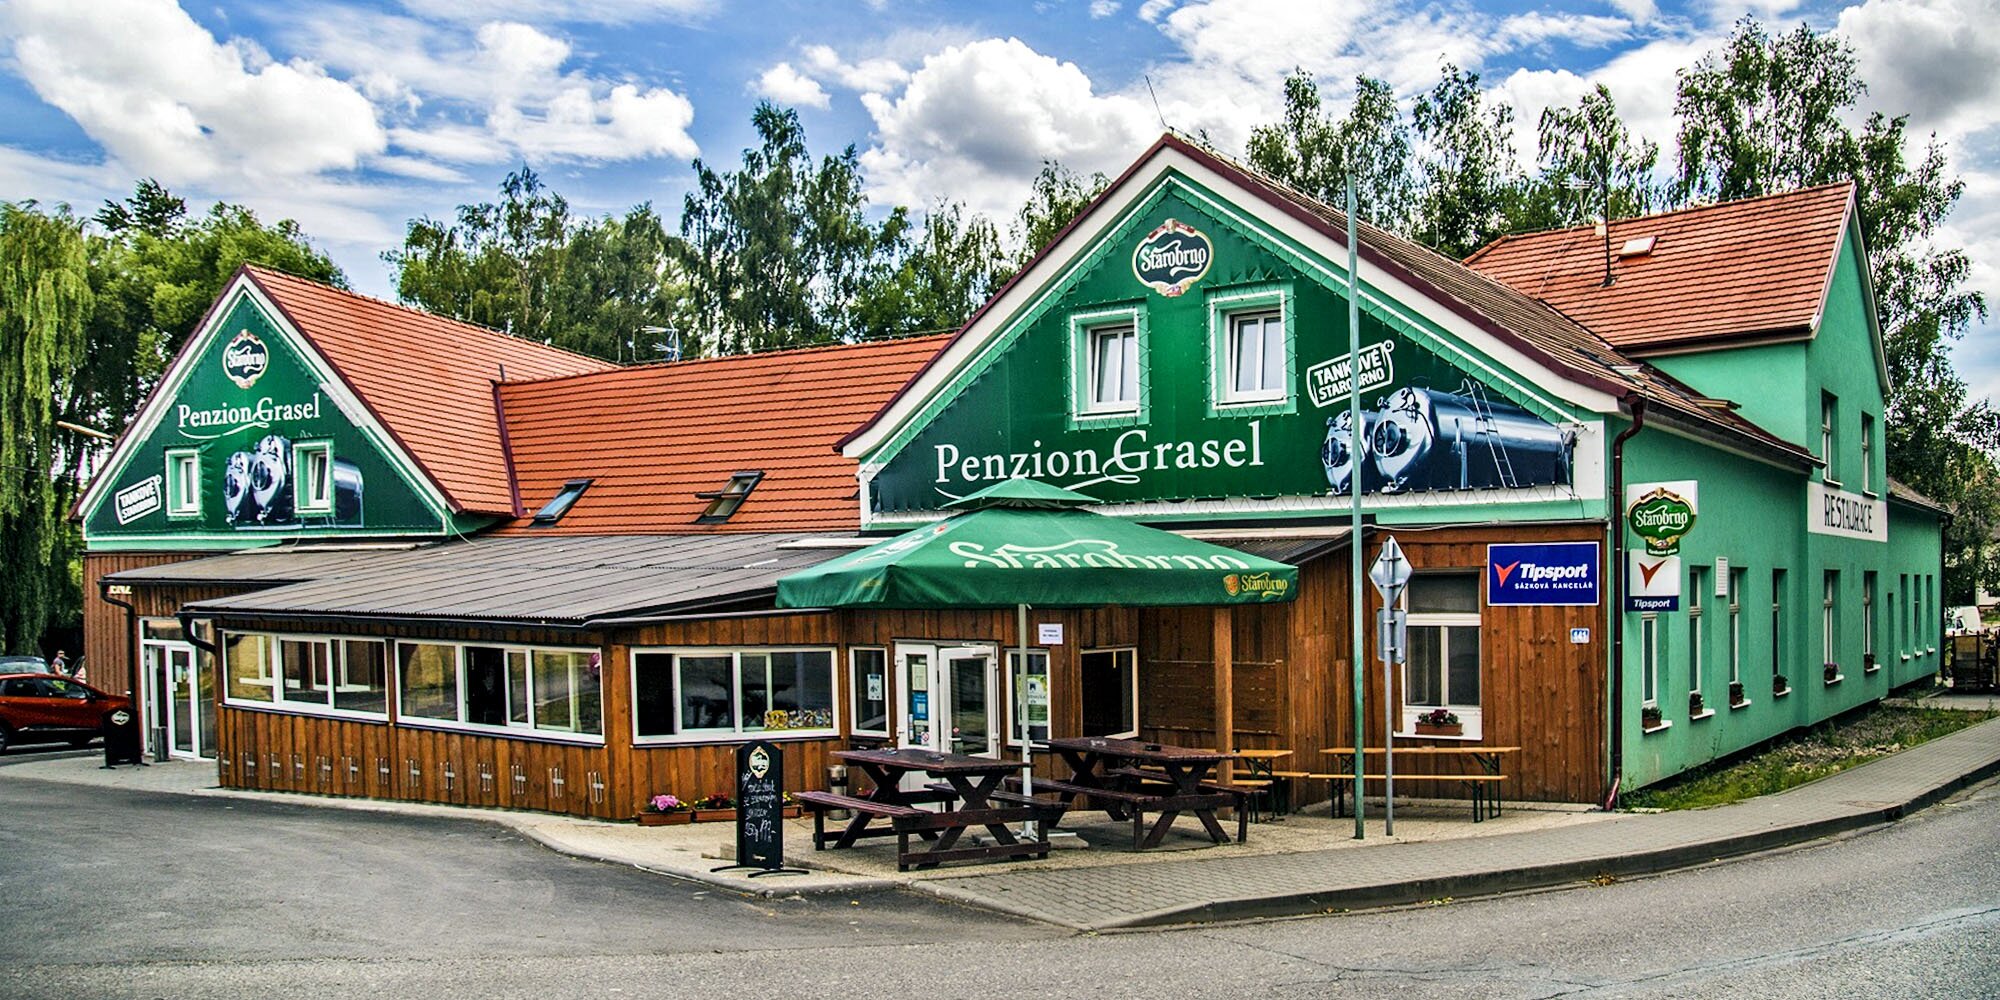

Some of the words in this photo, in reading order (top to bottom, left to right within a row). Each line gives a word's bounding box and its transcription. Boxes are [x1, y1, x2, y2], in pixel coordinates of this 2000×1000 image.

[1140, 239, 1207, 277] Starobrno
[1319, 367, 1385, 400] STARORNO
[178, 402, 252, 428] Penzion
[252, 392, 321, 421] Grasel
[934, 440, 1100, 483] Penzion
[1103, 420, 1265, 474] Grasel
[1635, 505, 1688, 532] Starobrno
[1824, 493, 1873, 533] RESTAURACE
[1241, 571, 1288, 598] Starobrno
[1514, 581, 1550, 590] SÁZKOVÁ
[1552, 581, 1593, 590] KANCELÁŘ
[1519, 563, 1588, 581] Tipsport
[1634, 599, 1671, 609] Tipsport
